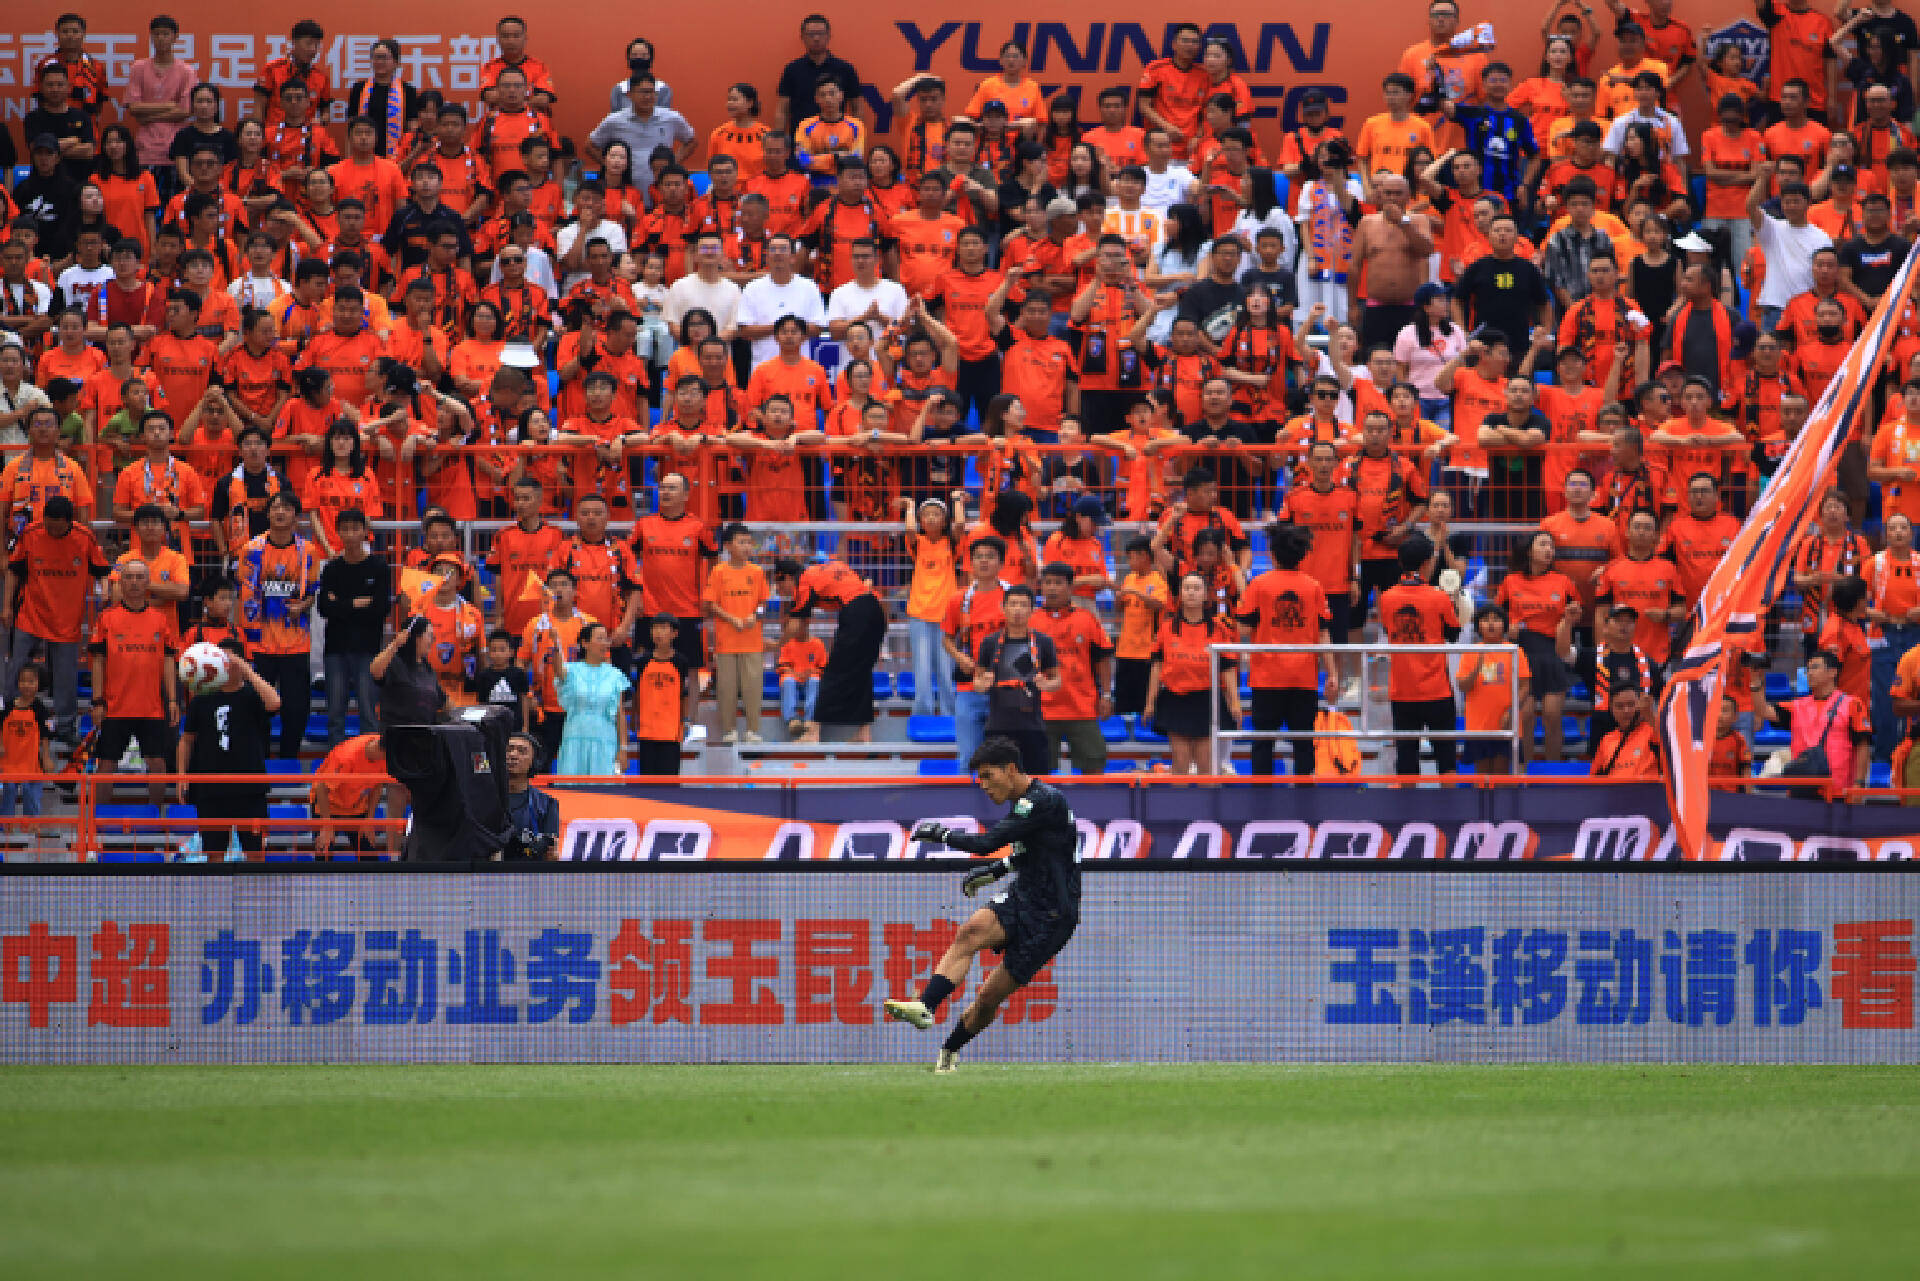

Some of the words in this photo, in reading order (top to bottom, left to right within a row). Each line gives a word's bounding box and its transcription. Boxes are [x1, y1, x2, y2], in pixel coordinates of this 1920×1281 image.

[893, 21, 1331, 73] YUNNAN
[3, 921, 170, 1028] 中超
[1325, 918, 1917, 1029] 玉溪移动请你看
